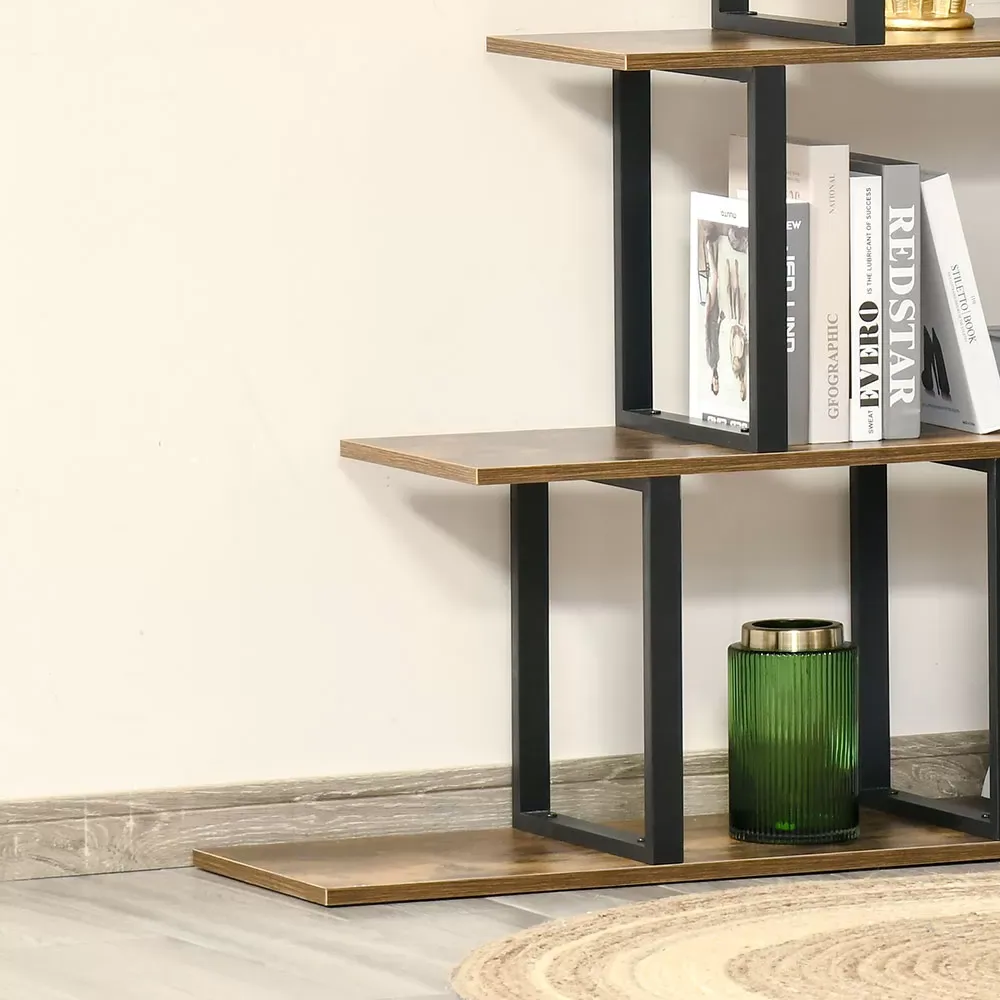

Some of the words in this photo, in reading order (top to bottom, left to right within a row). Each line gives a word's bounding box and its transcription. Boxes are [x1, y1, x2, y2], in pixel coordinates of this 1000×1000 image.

[828, 173, 836, 215] NATIONAL
[786, 220, 802, 230] EW
[865, 221, 872, 231] OF
[865, 232, 873, 272] LUBRICANT
[866, 287, 873, 295] IS
[888, 205, 916, 408] REDSTAR
[859, 300, 879, 409] EVERO
